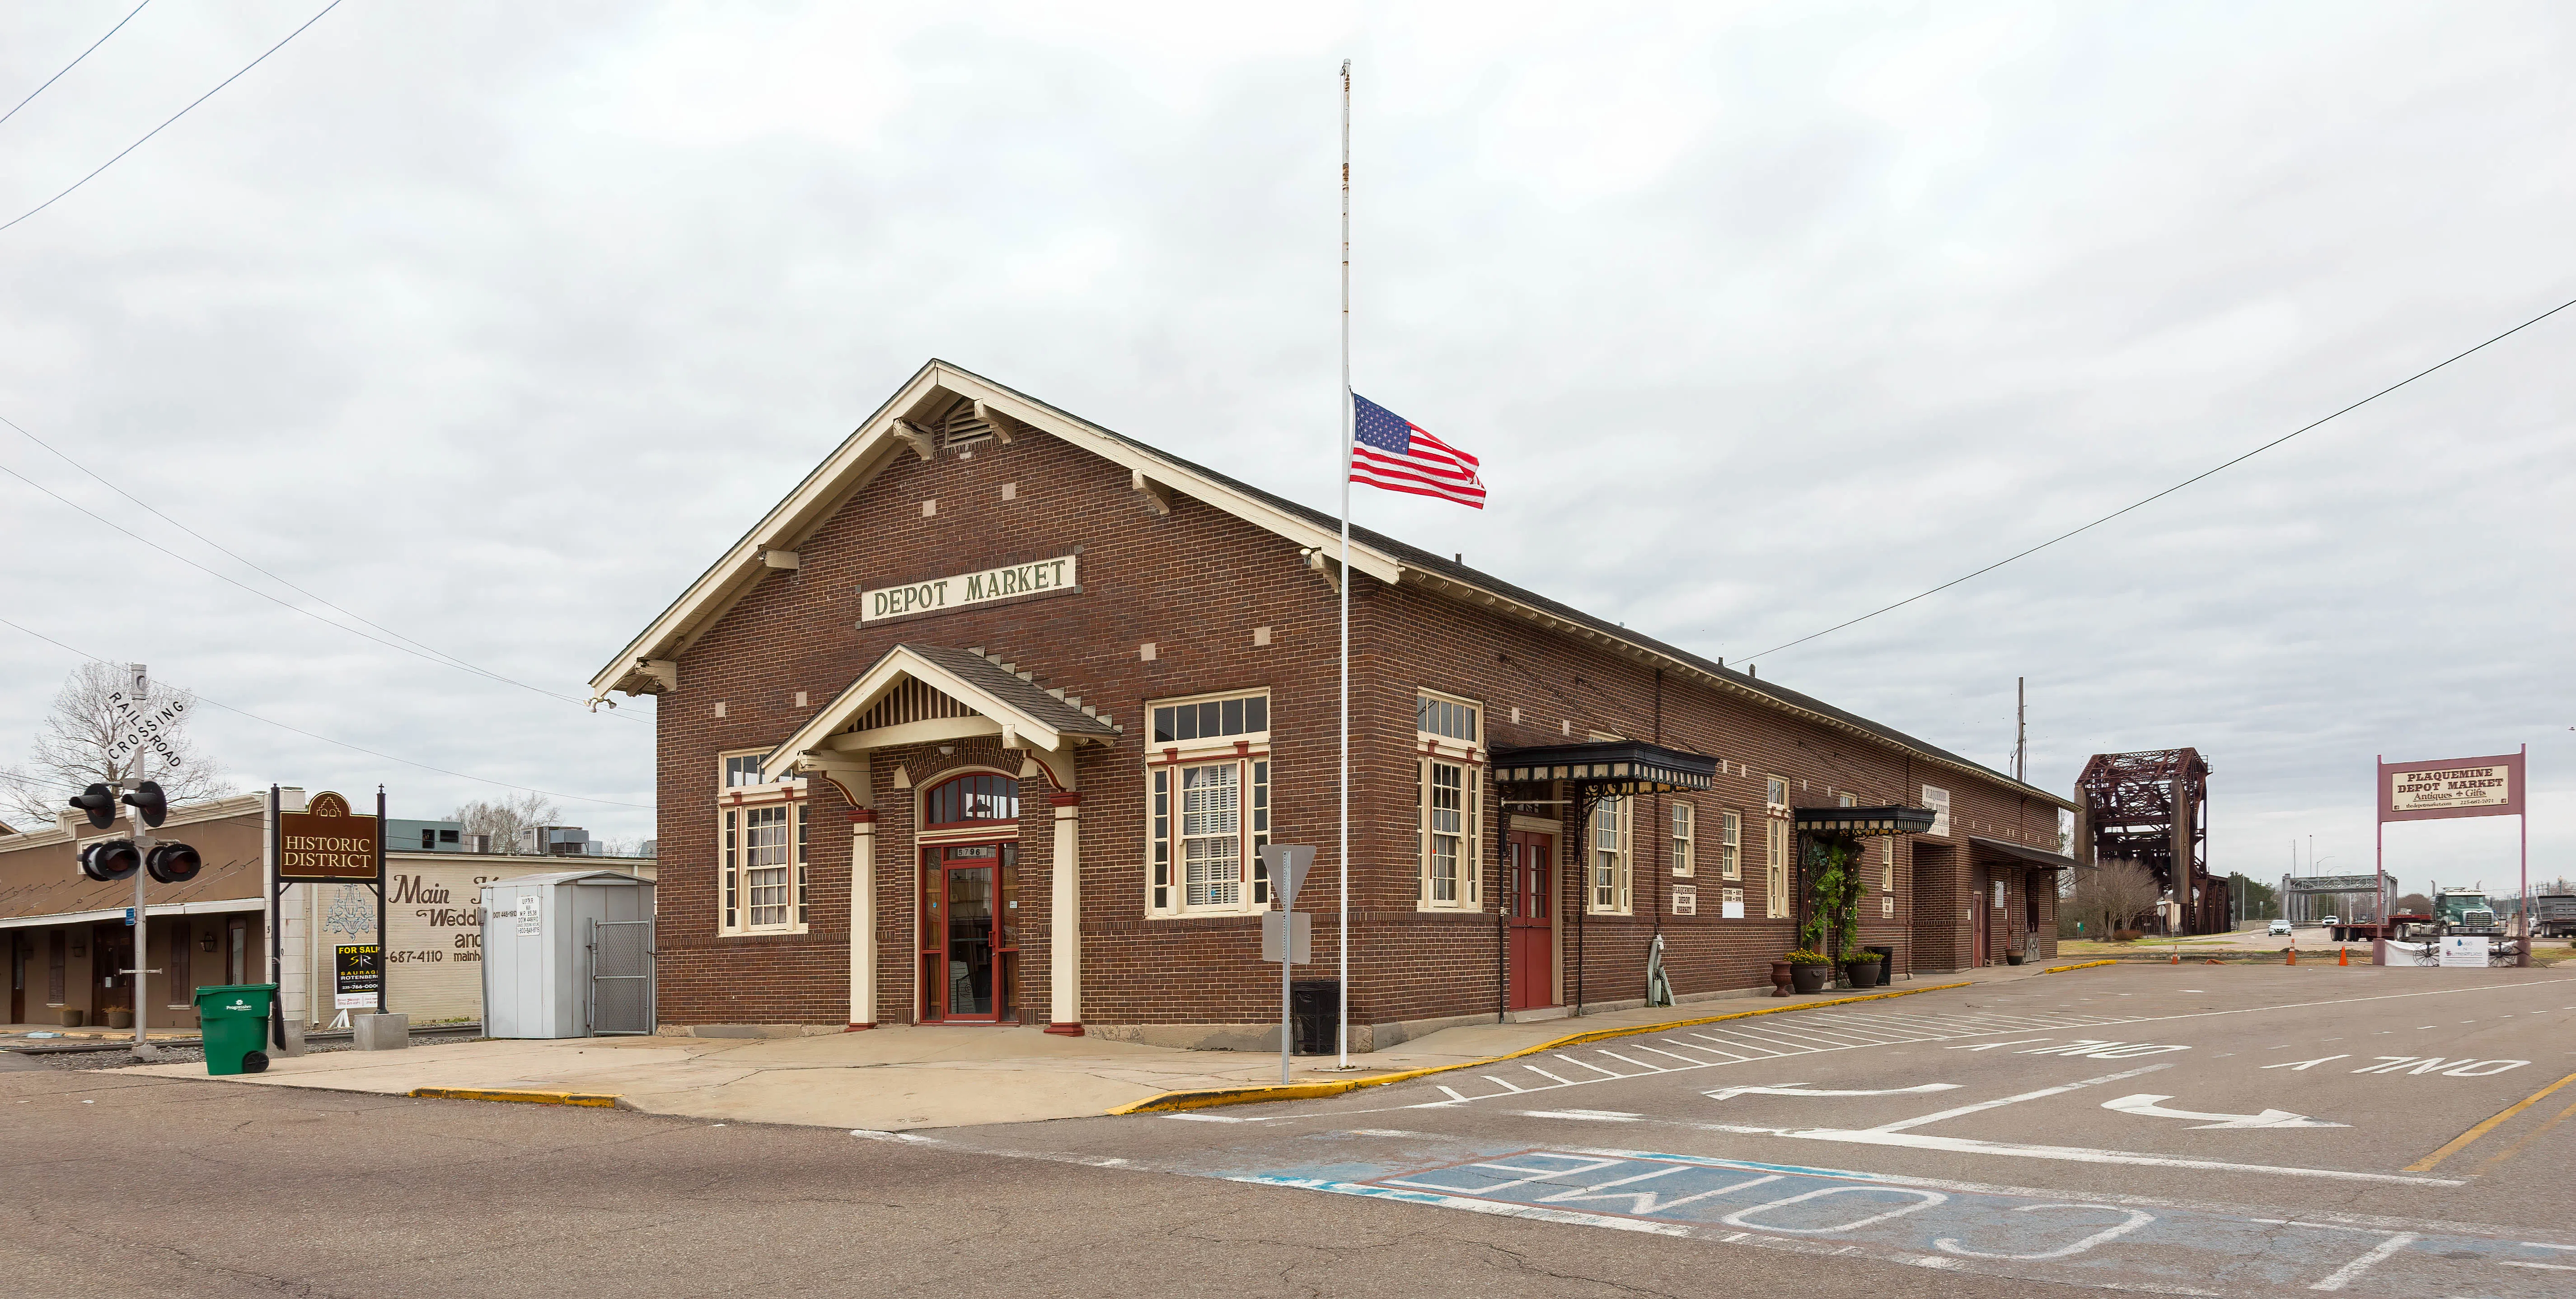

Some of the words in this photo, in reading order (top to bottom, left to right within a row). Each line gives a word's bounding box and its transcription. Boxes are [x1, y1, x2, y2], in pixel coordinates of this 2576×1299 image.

[875, 581, 947, 616] DEPOT
[965, 560, 1065, 601] MARKET
[109, 692, 140, 726] RAIL
[108, 701, 183, 759] CROSSING
[149, 735, 180, 766] ROAD
[2407, 768, 2493, 781] PLAQUEMINE
[2398, 783, 2440, 793] DEPOT
[2448, 778, 2504, 790] MARKET
[2414, 792, 2452, 800] Antiques
[2465, 789, 2486, 797] Gifts
[286, 836, 370, 852] HISTORIC
[284, 853, 371, 868] DISTRICT
[388, 875, 450, 904] Main
[1672, 886, 1695, 895] PLAQUEMINE
[416, 909, 480, 926] Wedd
[454, 950, 482, 962] mainh
[2259, 1054, 2532, 1077] ONLY
